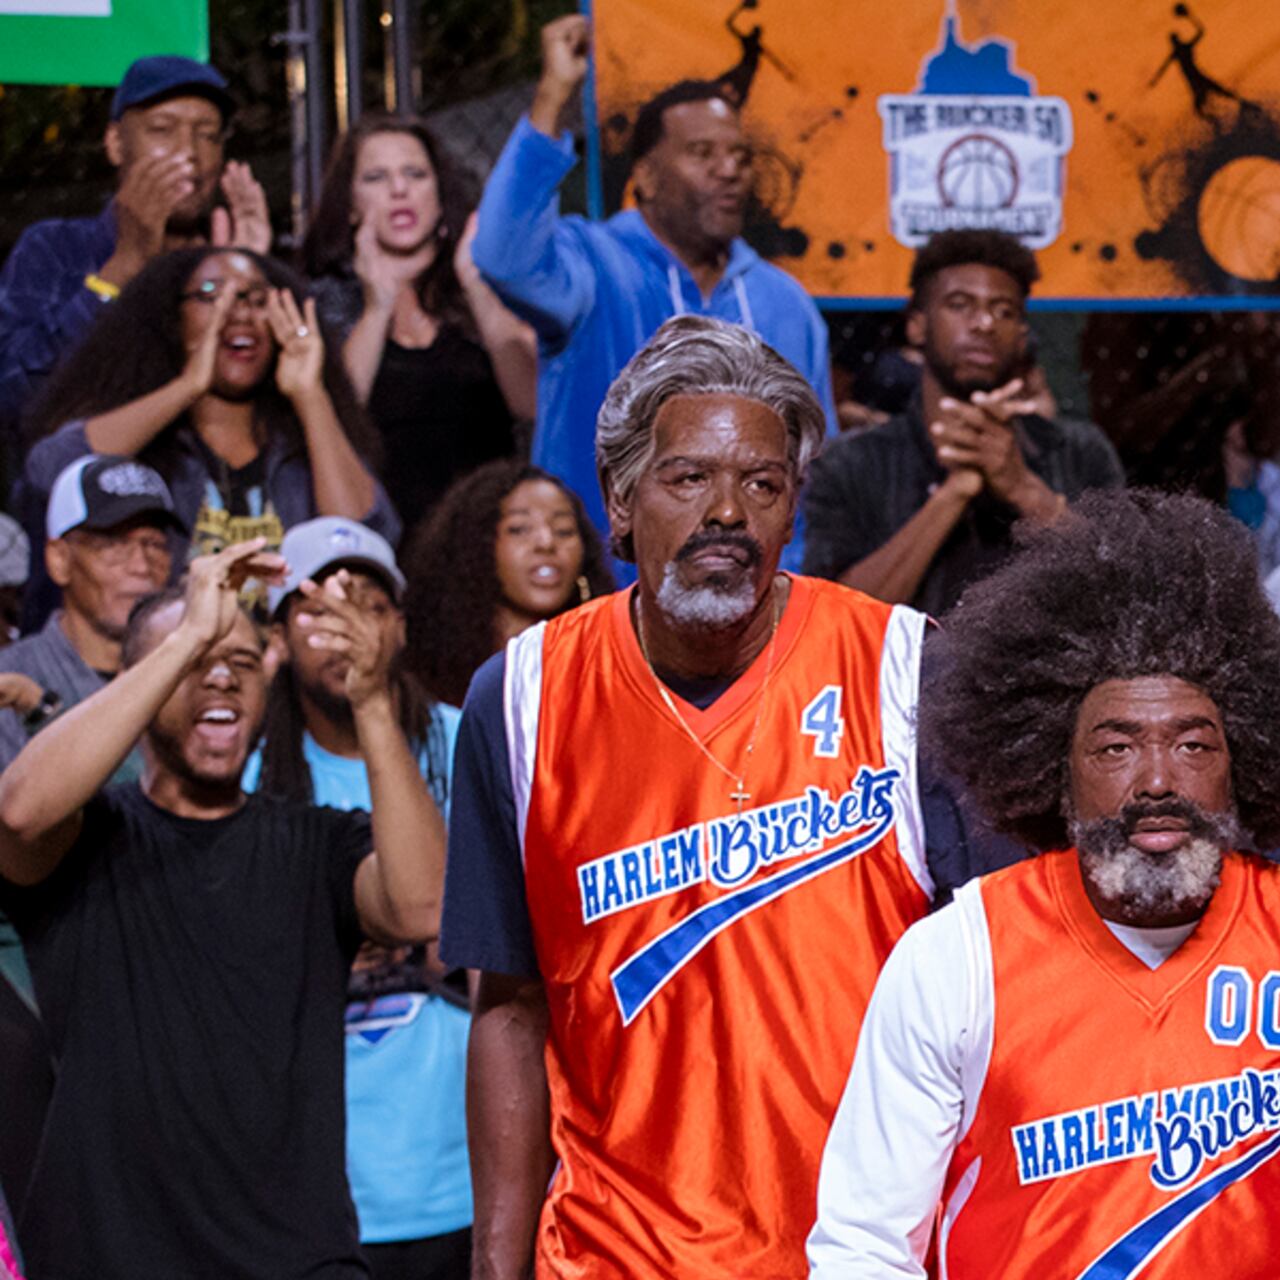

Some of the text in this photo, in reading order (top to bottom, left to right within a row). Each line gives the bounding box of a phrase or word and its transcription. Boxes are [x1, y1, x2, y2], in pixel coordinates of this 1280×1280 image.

[801, 685, 844, 758] 4
[577, 767, 901, 924] HARLEM Buckets
[1012, 1096, 1156, 1185] HARLEM
